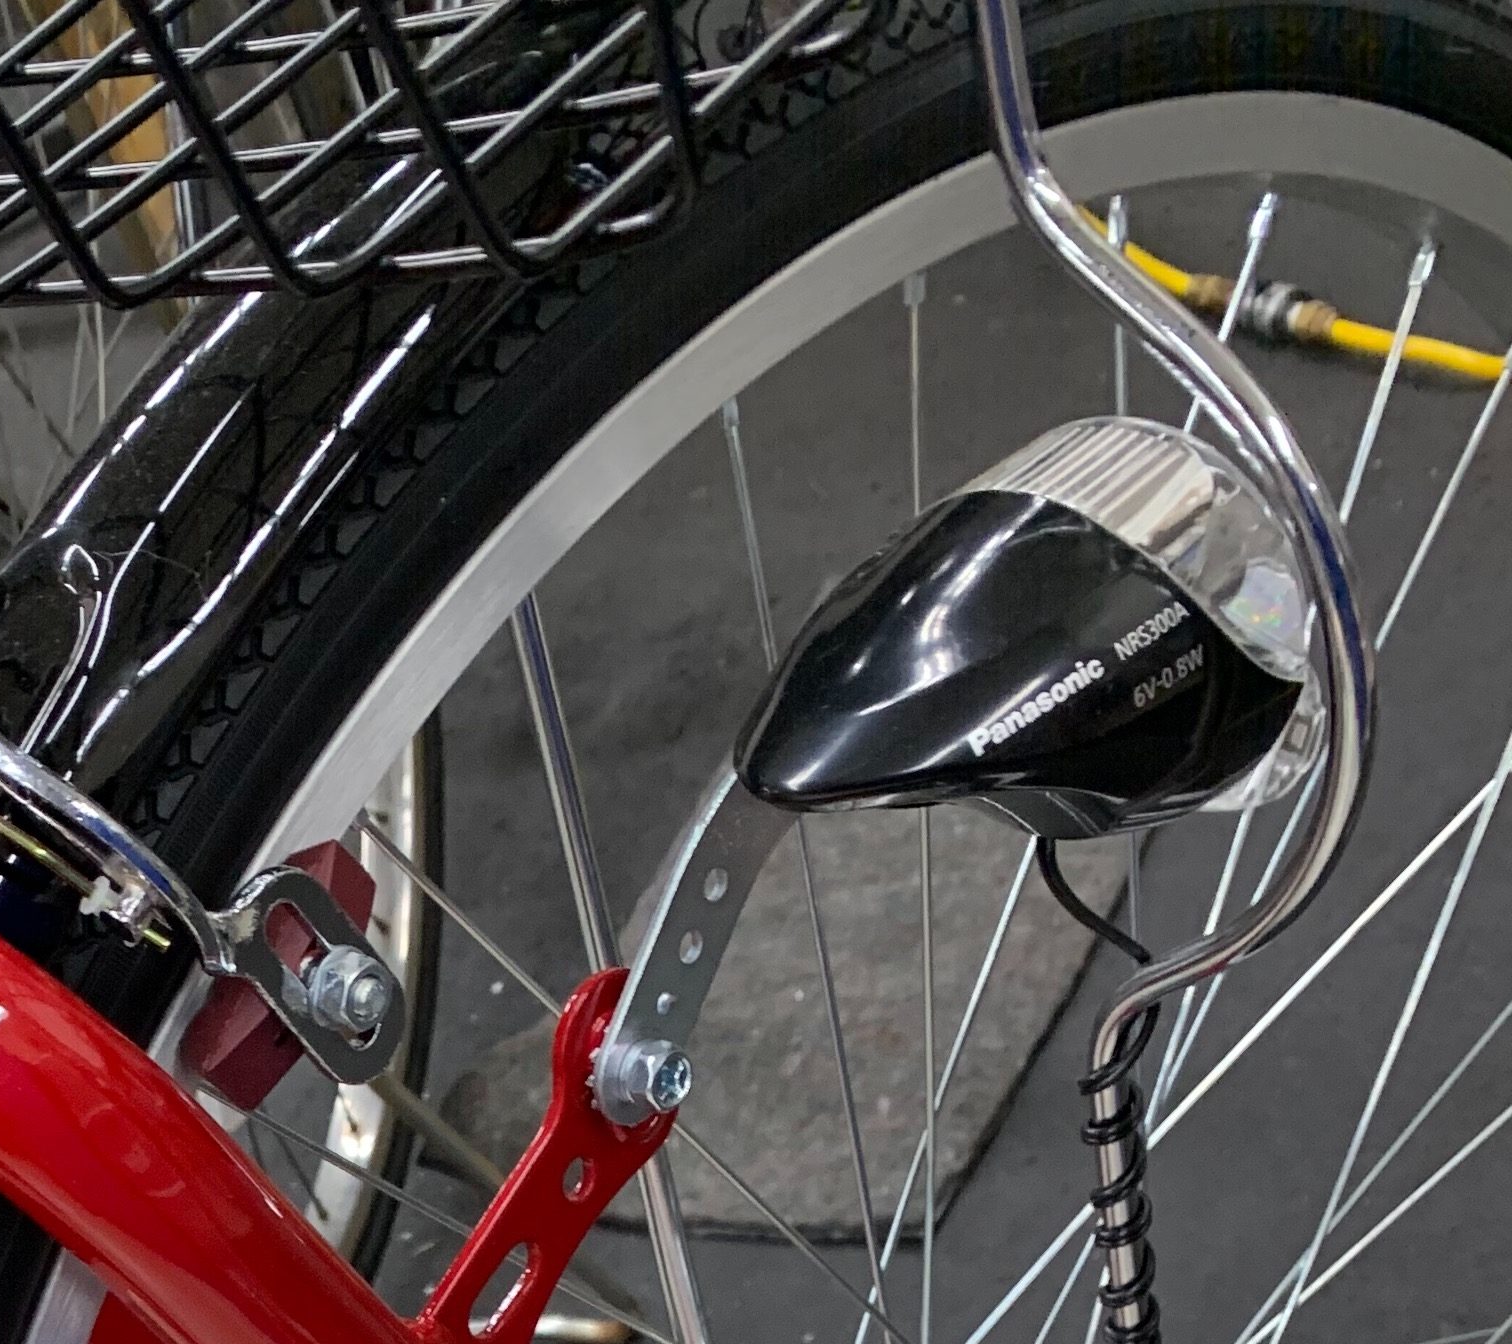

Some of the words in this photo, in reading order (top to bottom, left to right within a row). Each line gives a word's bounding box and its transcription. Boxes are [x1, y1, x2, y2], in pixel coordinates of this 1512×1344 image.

[1114, 602, 1190, 660] NRS300A
[966, 658, 1105, 757] Panasonic
[1134, 644, 1205, 708] 6V-0.8W
